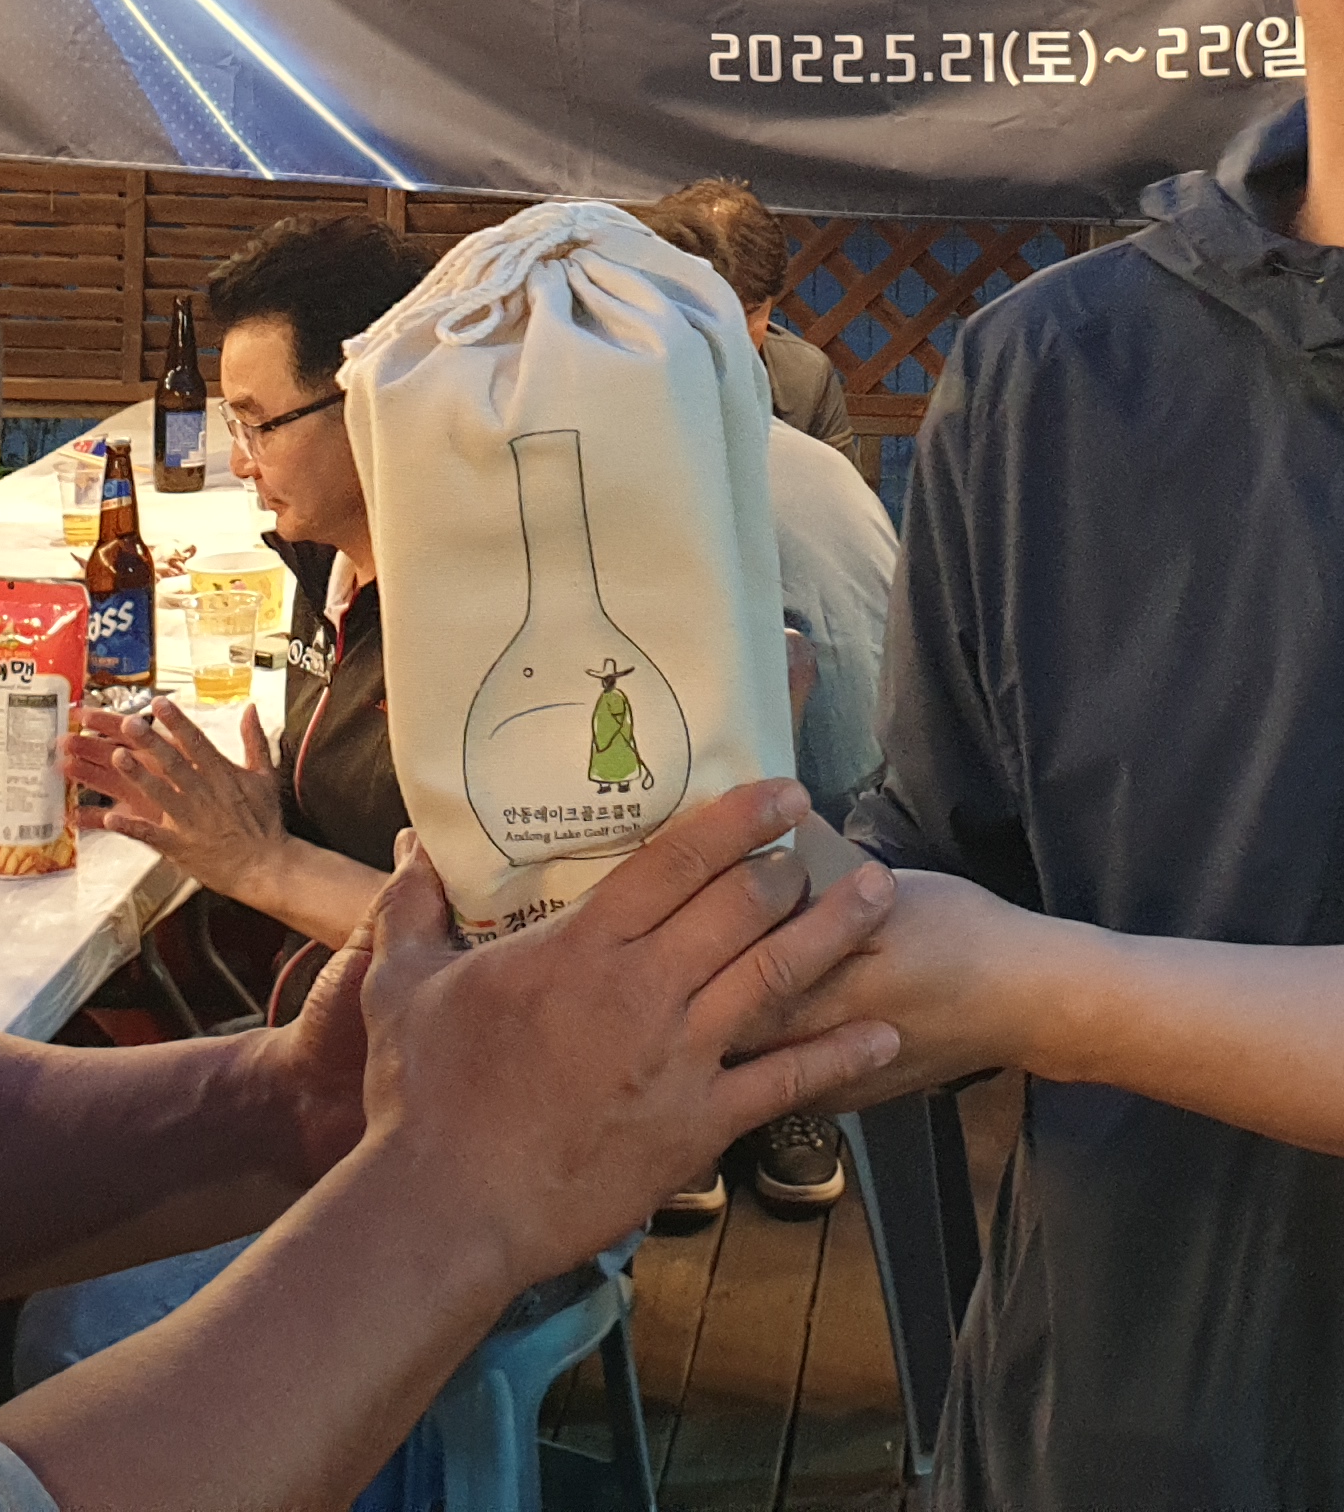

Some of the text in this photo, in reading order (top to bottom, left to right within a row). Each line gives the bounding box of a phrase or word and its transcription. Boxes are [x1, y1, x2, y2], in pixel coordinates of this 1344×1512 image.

[87, 600, 134, 642] ass
[505, 830, 551, 843] Andong
[554, 829, 582, 840] Lake
[583, 827, 609, 838] Golf
